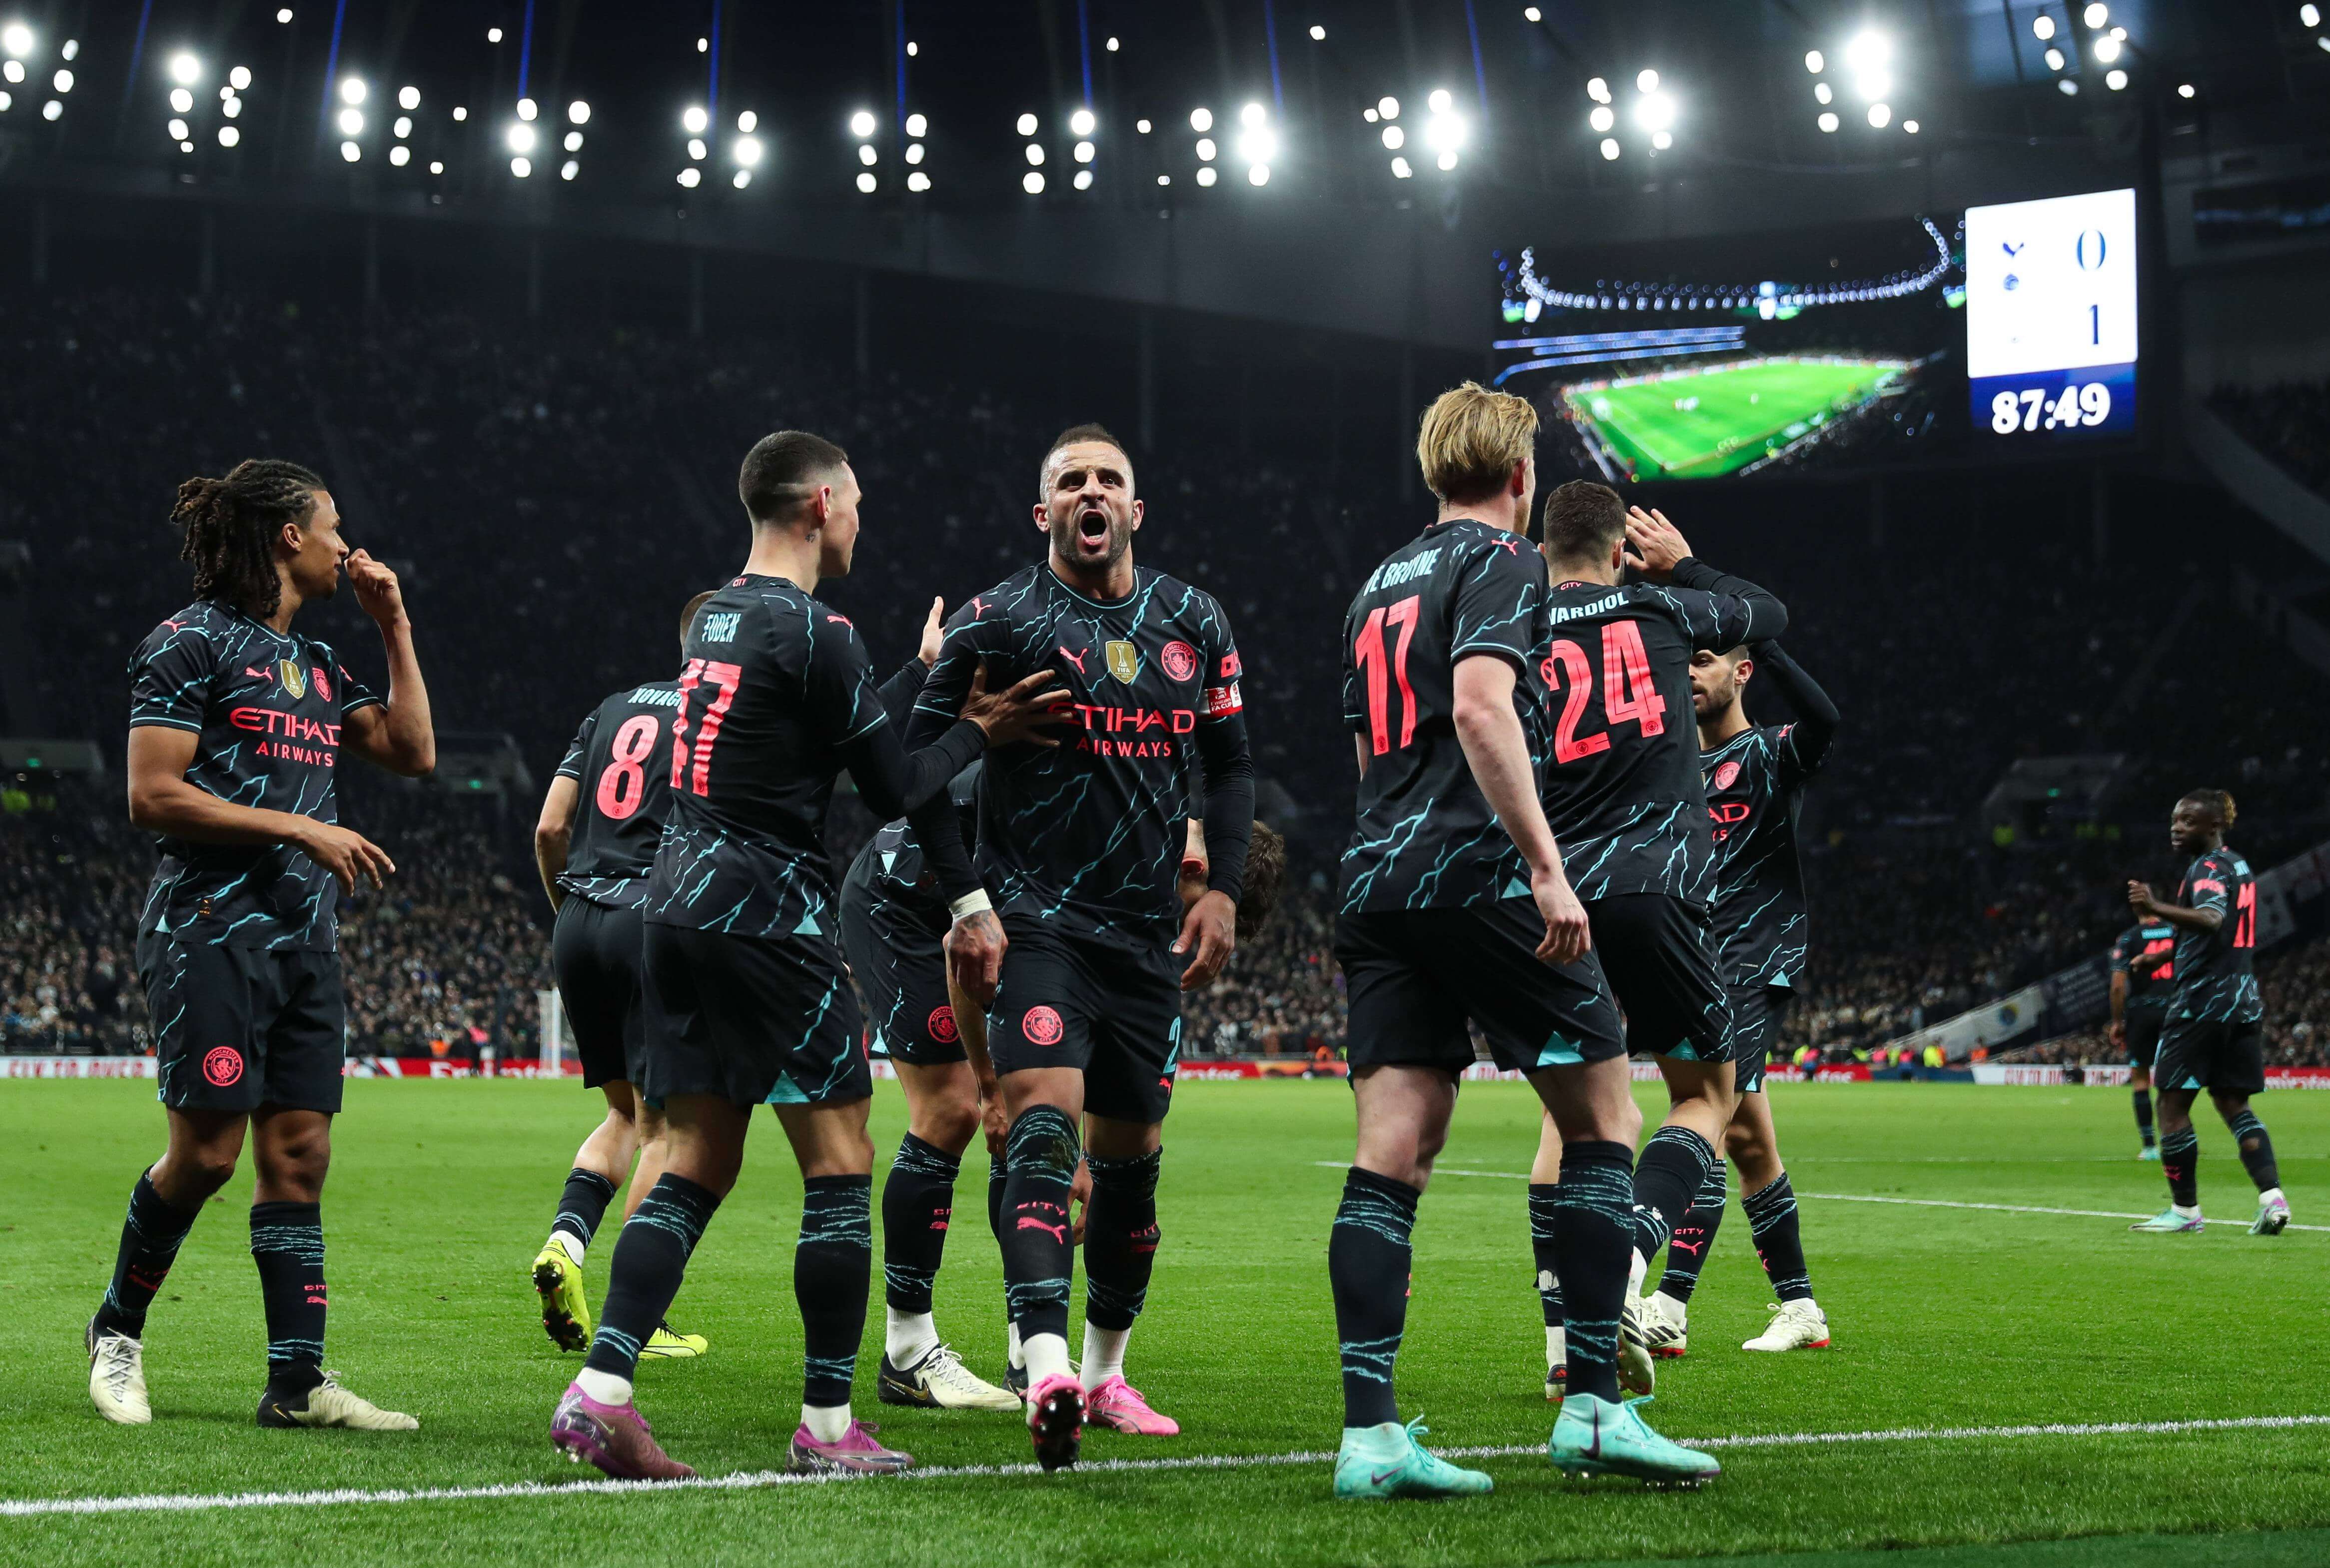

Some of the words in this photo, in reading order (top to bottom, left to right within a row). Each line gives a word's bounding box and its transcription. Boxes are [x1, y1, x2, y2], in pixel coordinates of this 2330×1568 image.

[2077, 229, 2106, 270] 0
[2089, 303, 2099, 345] 1
[1992, 382, 2112, 434] 87:49
[733, 577, 748, 587] CITY
[1380, 547, 1443, 590] BRUYNE
[1560, 582, 1582, 591] CITY
[1549, 591, 1629, 626] VARDIOL
[702, 613, 742, 643] FODEN
[1165, 644, 1191, 657] MANCHESTER
[1355, 595, 1420, 756] 17
[1540, 620, 1666, 765] 24
[255, 741, 334, 768] AIRWAYS
[1076, 737, 1172, 757] AIRWAYS
[597, 715, 659, 820] 8
[209, 1049, 239, 1064] MANCHESTER
[1162, 1015, 1181, 1074] 2
